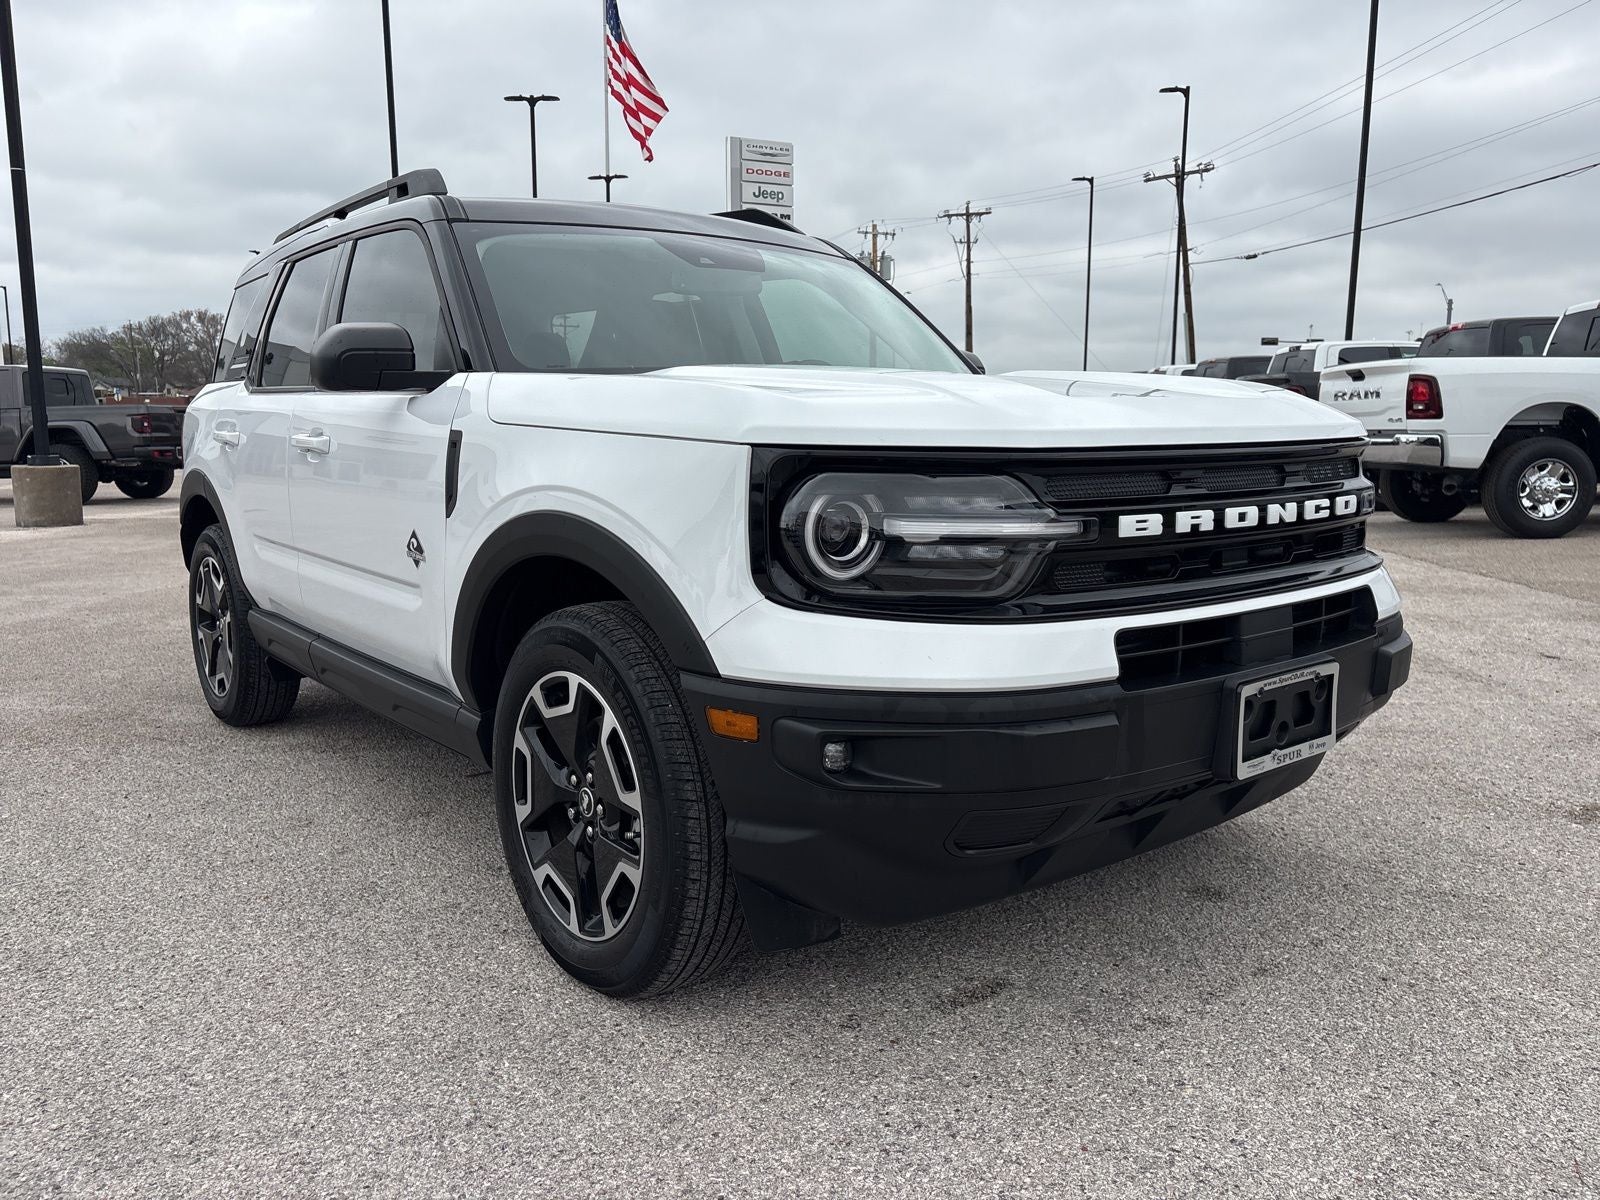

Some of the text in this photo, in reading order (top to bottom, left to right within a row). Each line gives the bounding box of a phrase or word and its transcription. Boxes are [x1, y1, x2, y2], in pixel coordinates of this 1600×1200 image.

[746, 143, 790, 152] CHRYSLER
[746, 168, 790, 178] DODGE
[752, 186, 784, 202] Jeep
[1333, 389, 1382, 401] RAM
[1118, 494, 1357, 537] BRONCO
[1276, 748, 1302, 765] SPUR
